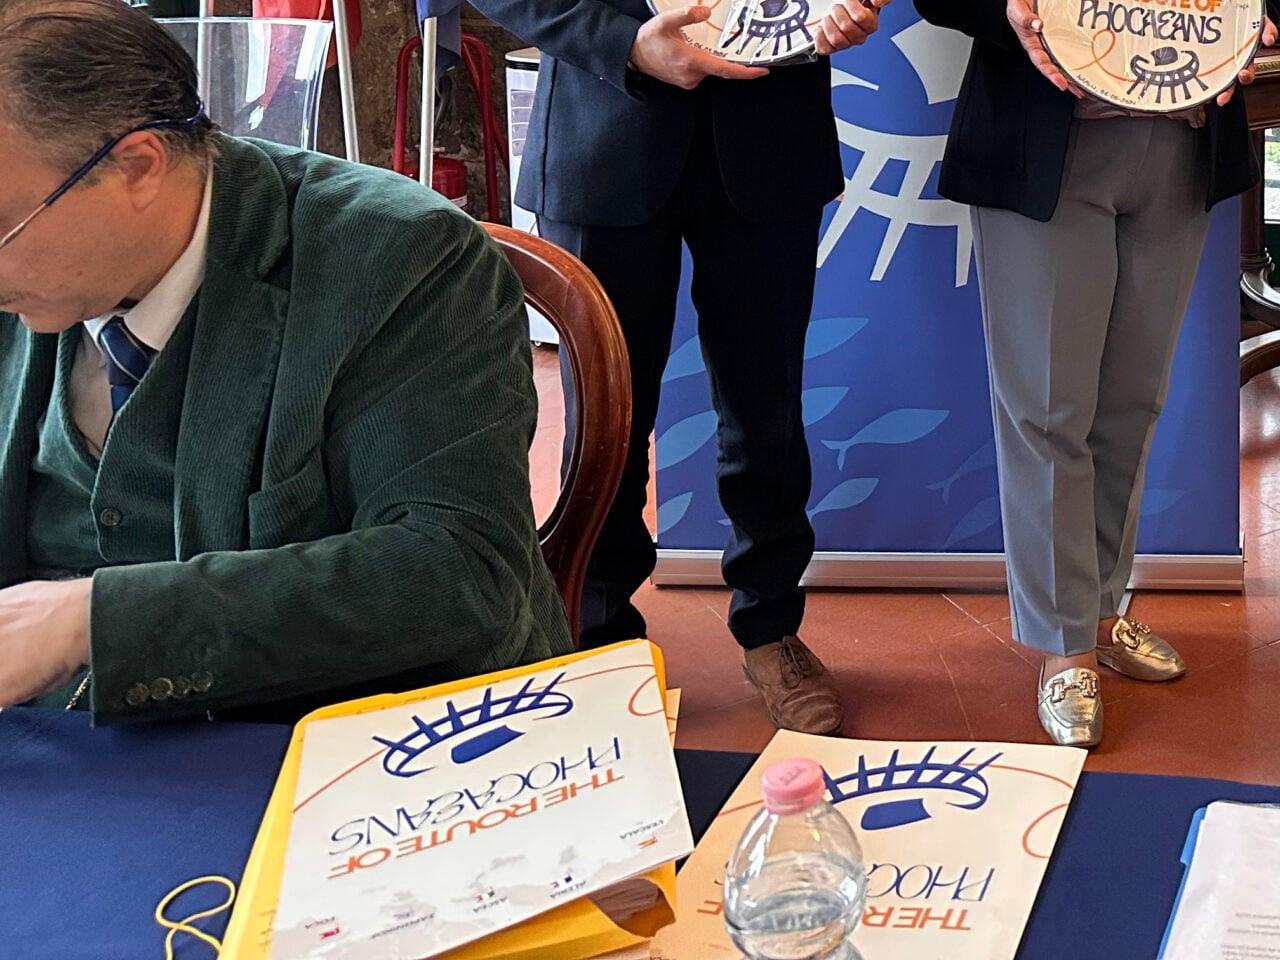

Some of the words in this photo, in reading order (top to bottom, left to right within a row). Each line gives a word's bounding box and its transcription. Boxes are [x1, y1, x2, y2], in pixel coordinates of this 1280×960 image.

[329, 737, 622, 855] PHOCAEANS
[543, 767, 625, 809] THE
[396, 796, 538, 858] ROUTE
[327, 847, 392, 880] OF
[892, 907, 971, 930] THE
